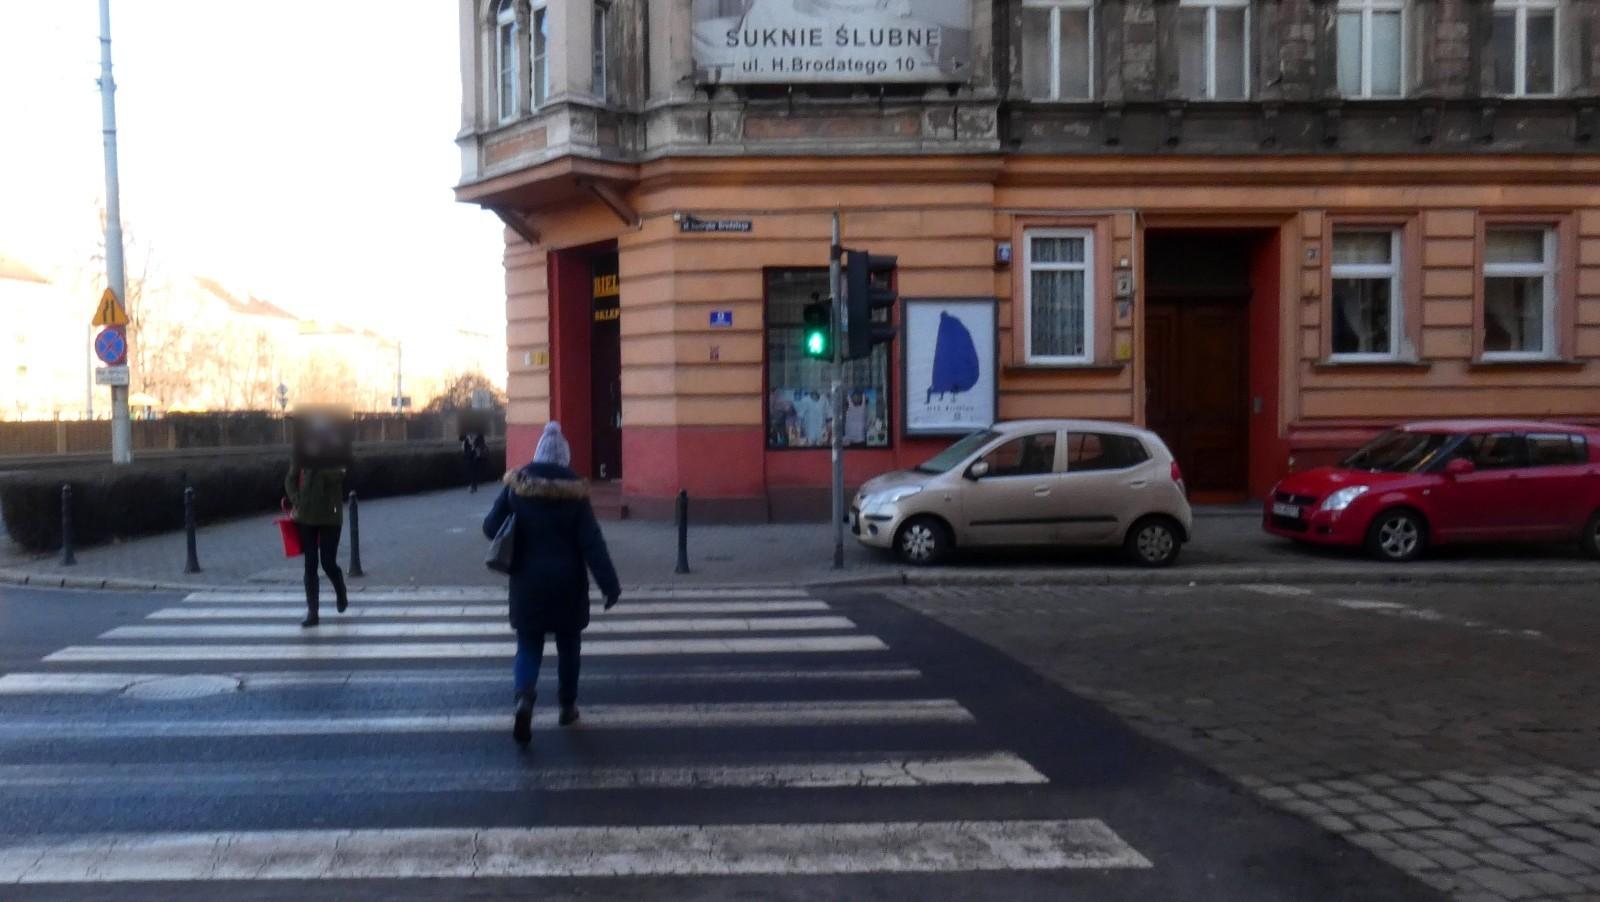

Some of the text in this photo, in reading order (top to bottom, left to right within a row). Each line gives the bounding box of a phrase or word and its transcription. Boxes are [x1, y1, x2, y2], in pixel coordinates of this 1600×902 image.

[726, 23, 940, 47] SUKNIE ŚLUBNE
[742, 56, 915, 74] ul. H.Brodatego 10
